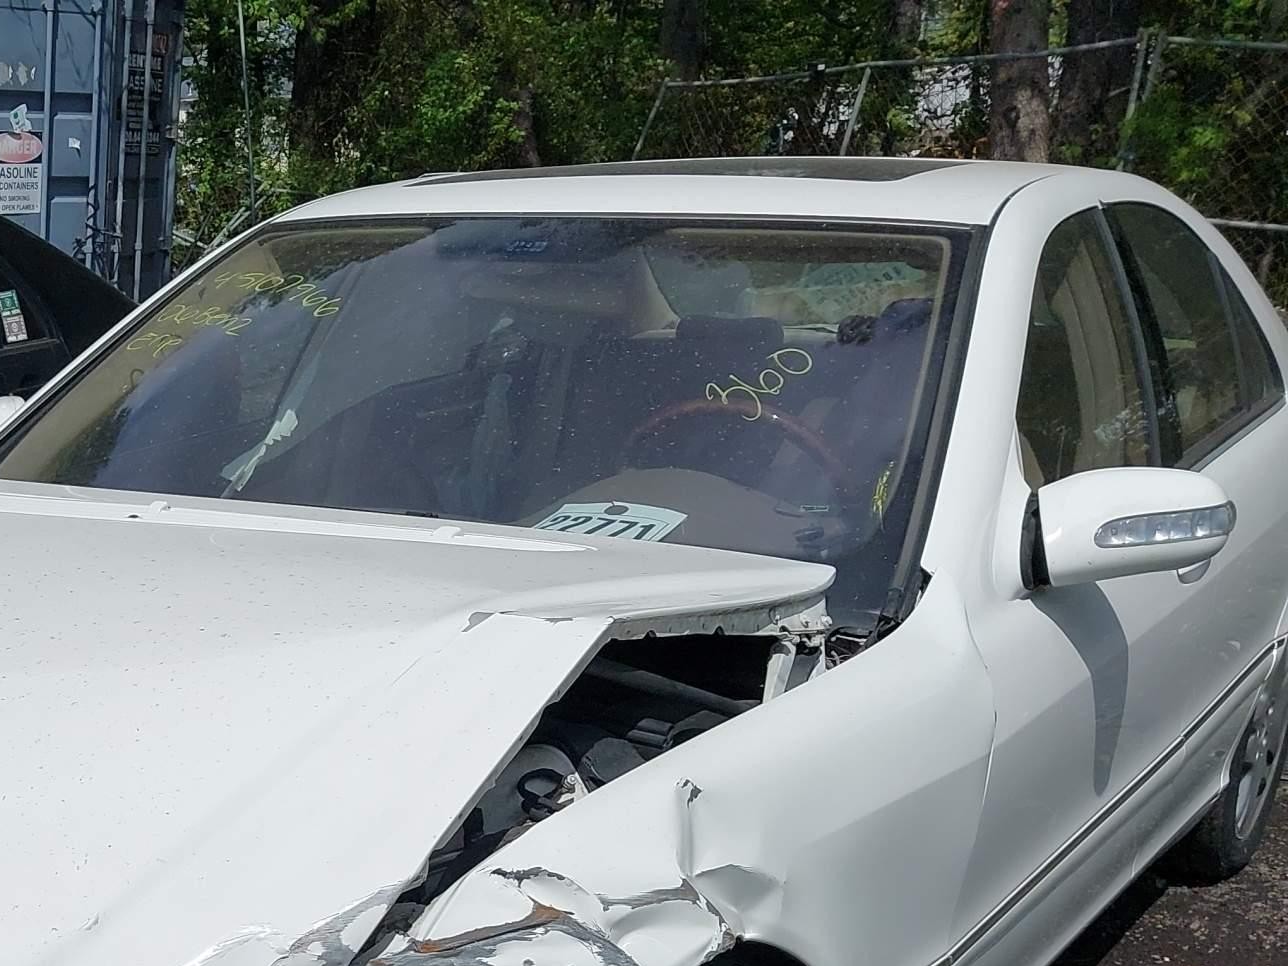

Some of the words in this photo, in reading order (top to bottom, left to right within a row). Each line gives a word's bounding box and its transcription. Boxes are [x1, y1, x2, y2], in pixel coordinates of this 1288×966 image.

[214, 271, 342, 318] 45107966
[705, 348, 812, 420] 360
[539, 514, 657, 540] 22771
